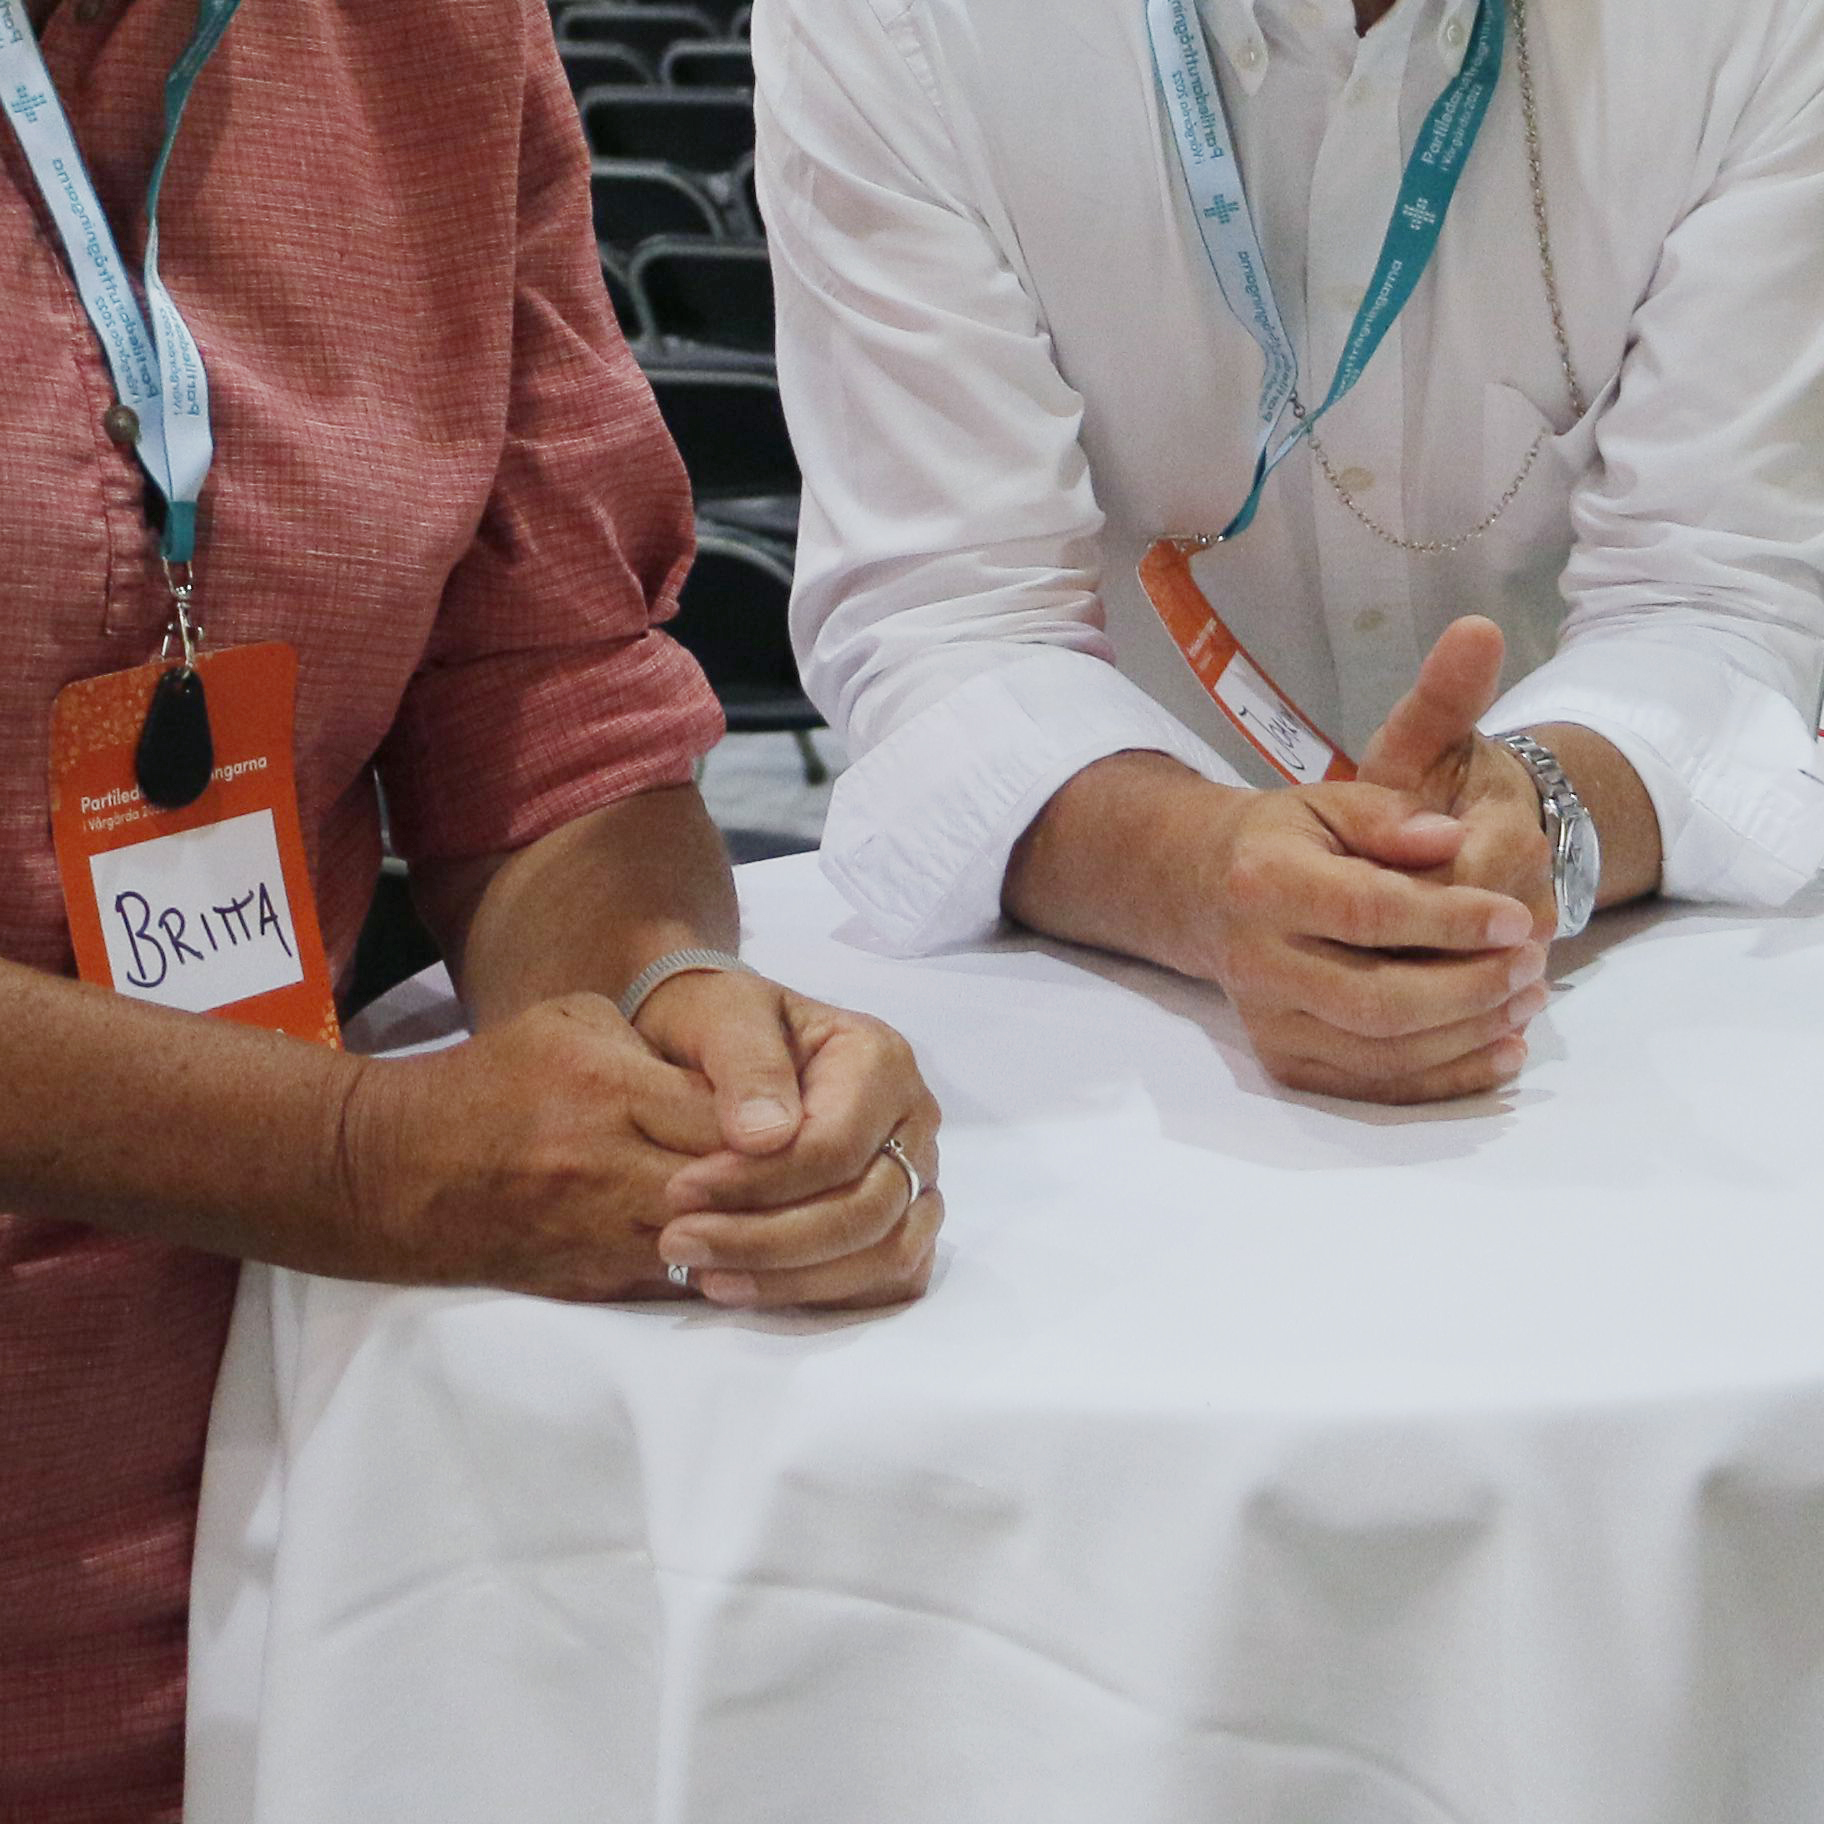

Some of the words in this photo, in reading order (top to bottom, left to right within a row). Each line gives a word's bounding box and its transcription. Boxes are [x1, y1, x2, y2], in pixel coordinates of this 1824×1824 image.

[80, 756, 267, 814] Partiledngarna
[88, 810, 141, 832] Vårgårda
[115, 882, 292, 988] BRITTA
